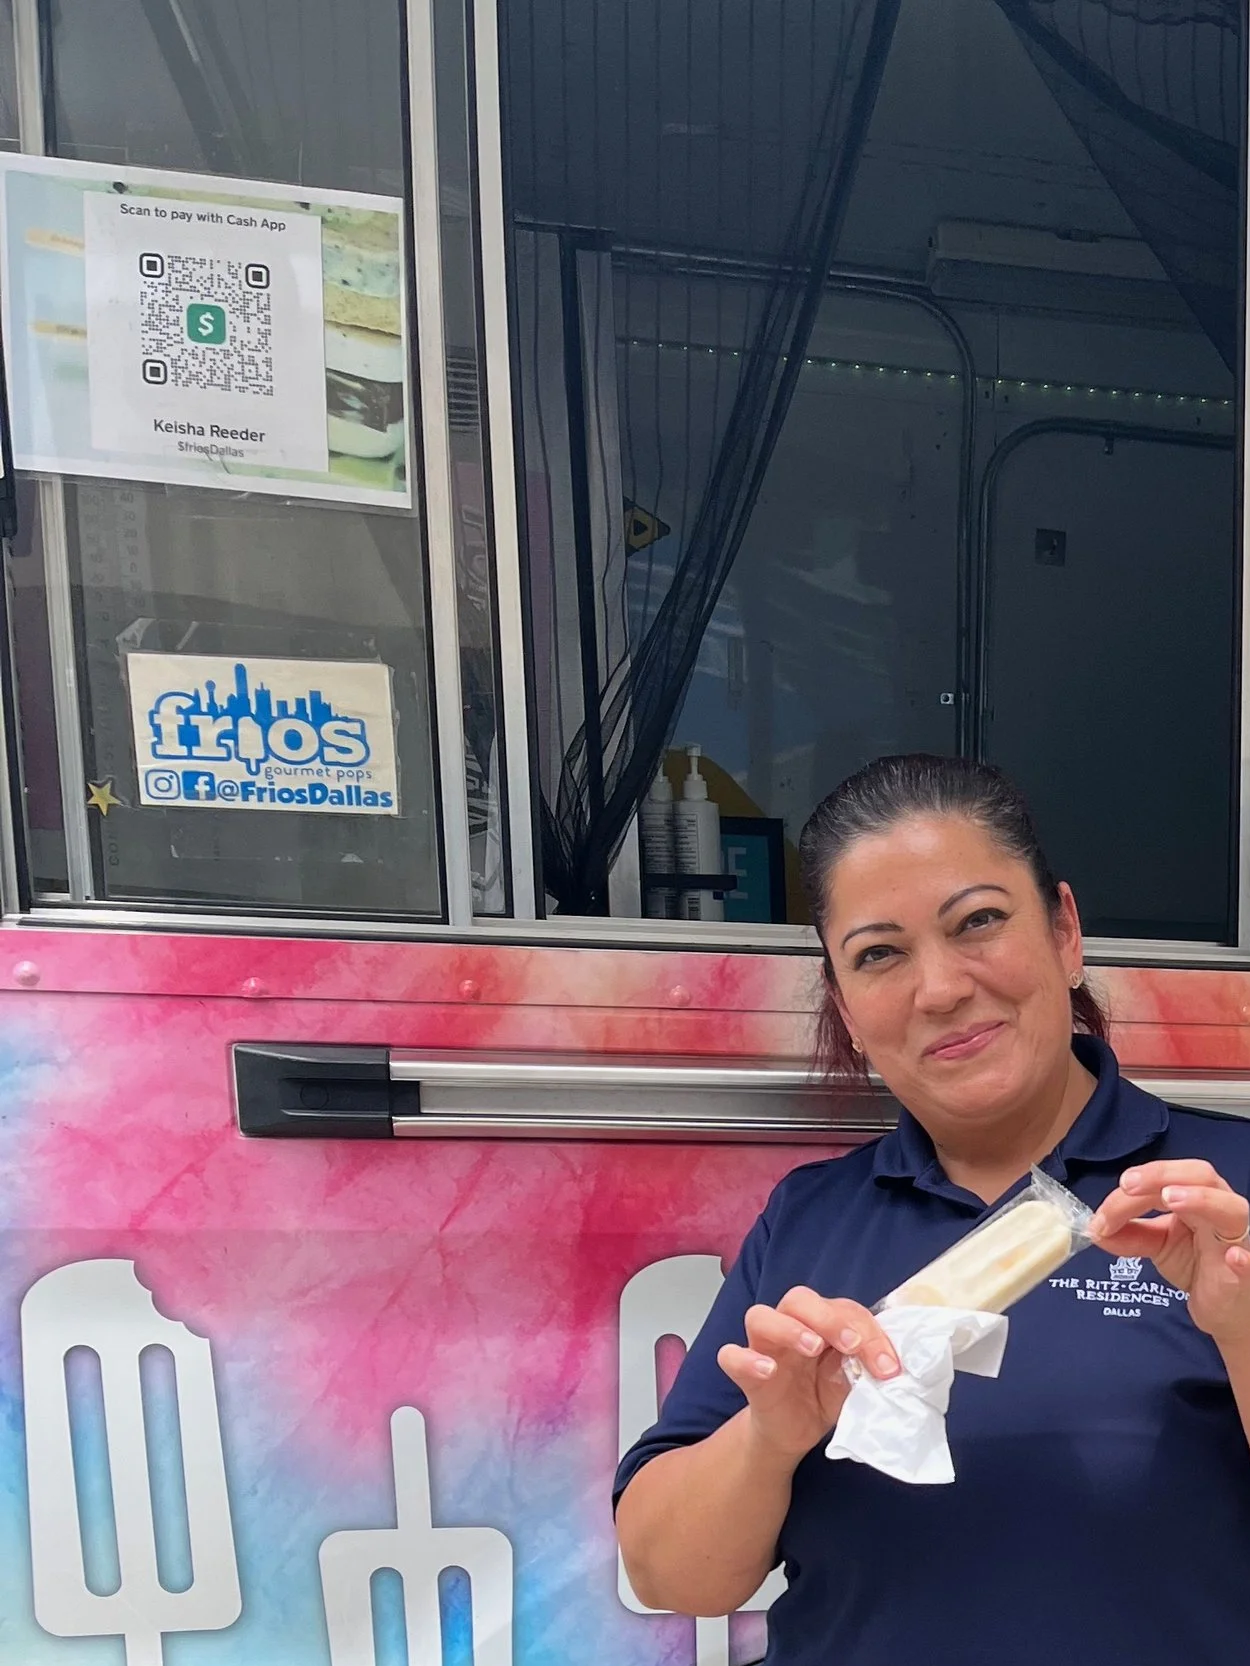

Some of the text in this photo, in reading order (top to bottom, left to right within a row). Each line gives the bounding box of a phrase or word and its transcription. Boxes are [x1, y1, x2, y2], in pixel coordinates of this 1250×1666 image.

[120, 203, 286, 232] Scan to pay with Cash App
[153, 418, 266, 443] Keisha Reeder
[264, 765, 373, 783] gourmet pops
[217, 779, 394, 809] @FriosDallas
[1049, 1278, 1080, 1289] THE
[1075, 1288, 1170, 1308] RESIDENCES
[1102, 1306, 1142, 1318] DALLAS
